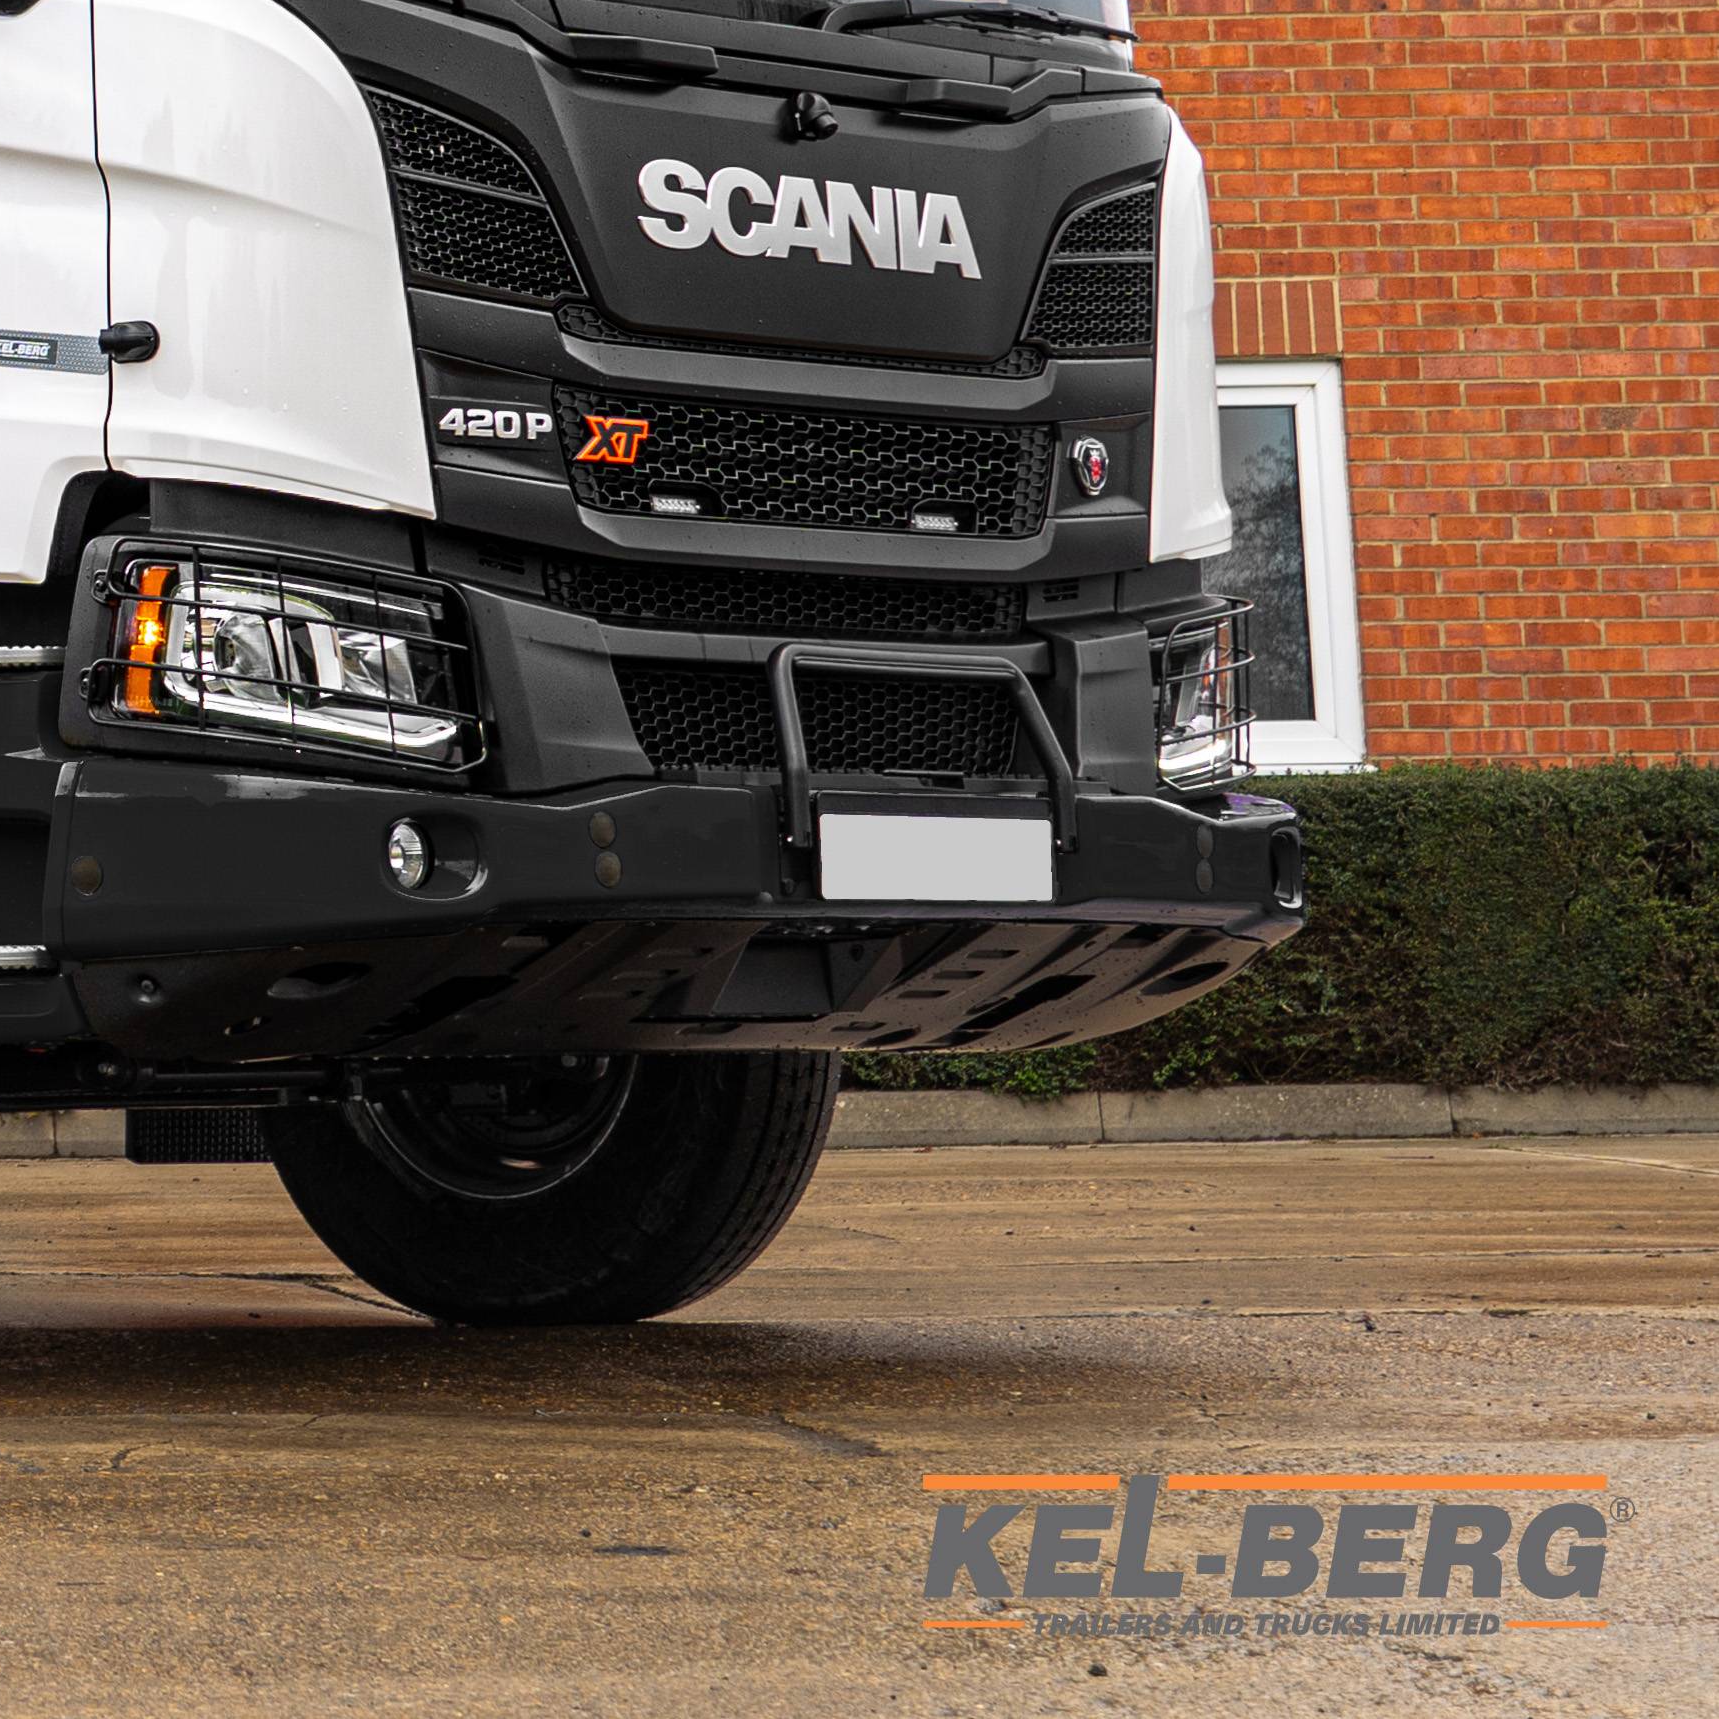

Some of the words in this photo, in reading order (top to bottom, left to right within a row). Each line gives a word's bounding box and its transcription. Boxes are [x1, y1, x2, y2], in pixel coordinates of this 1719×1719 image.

[637, 158, 982, 280] SCANIA
[439, 408, 521, 439] 420
[527, 412, 553, 440] P
[572, 415, 650, 464] XT
